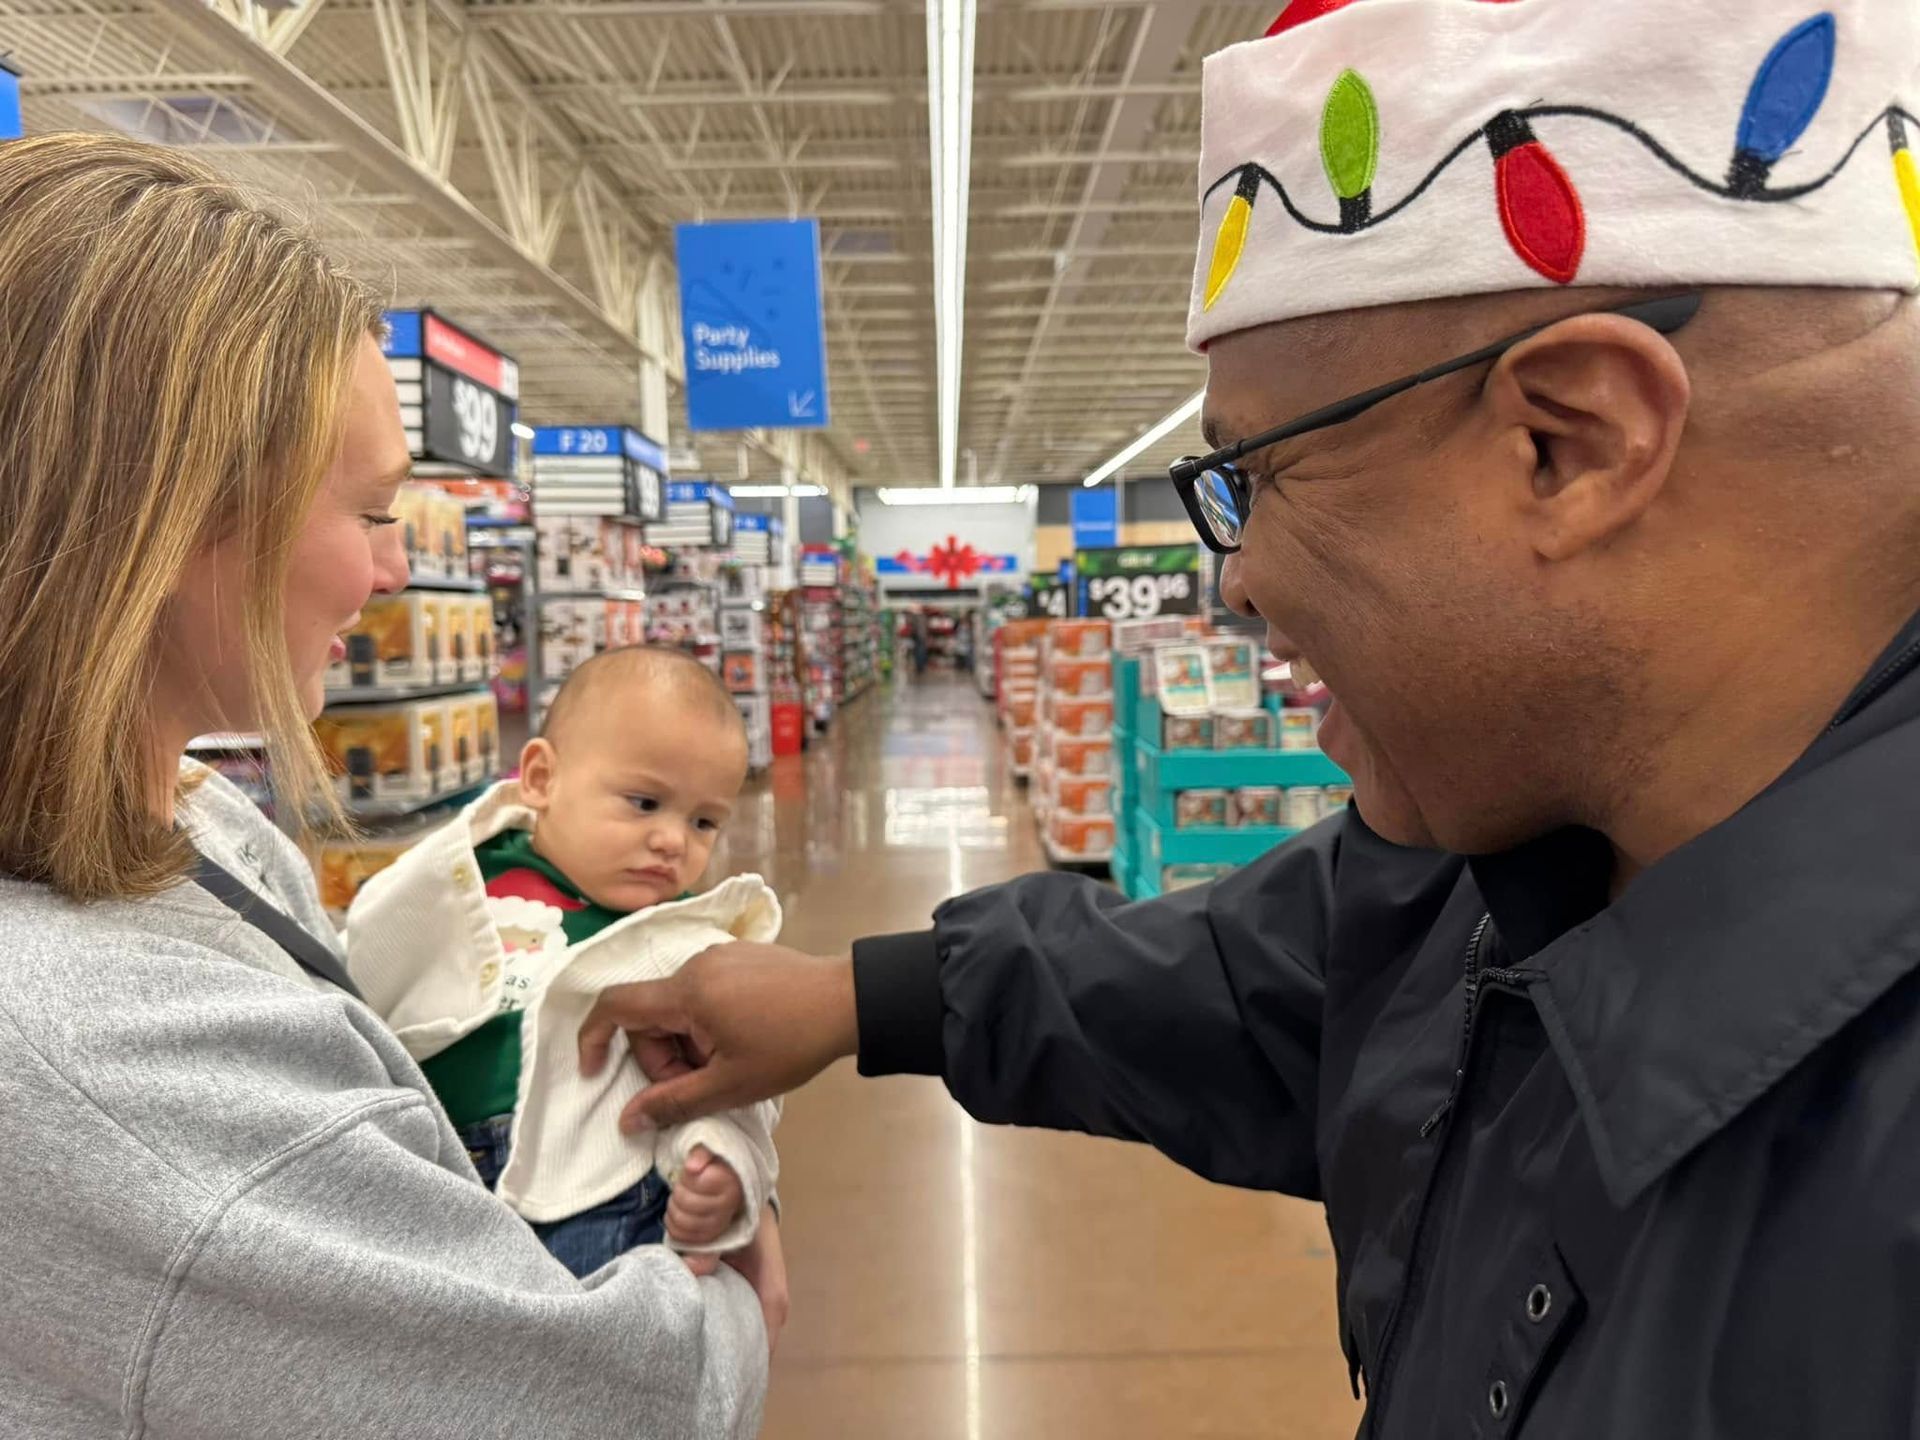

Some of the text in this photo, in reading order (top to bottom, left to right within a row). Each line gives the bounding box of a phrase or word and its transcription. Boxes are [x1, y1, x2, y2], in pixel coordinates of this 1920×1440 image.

[692, 322, 750, 350] Party
[695, 345, 781, 375] Supplies
[560, 429, 608, 453] F 20
